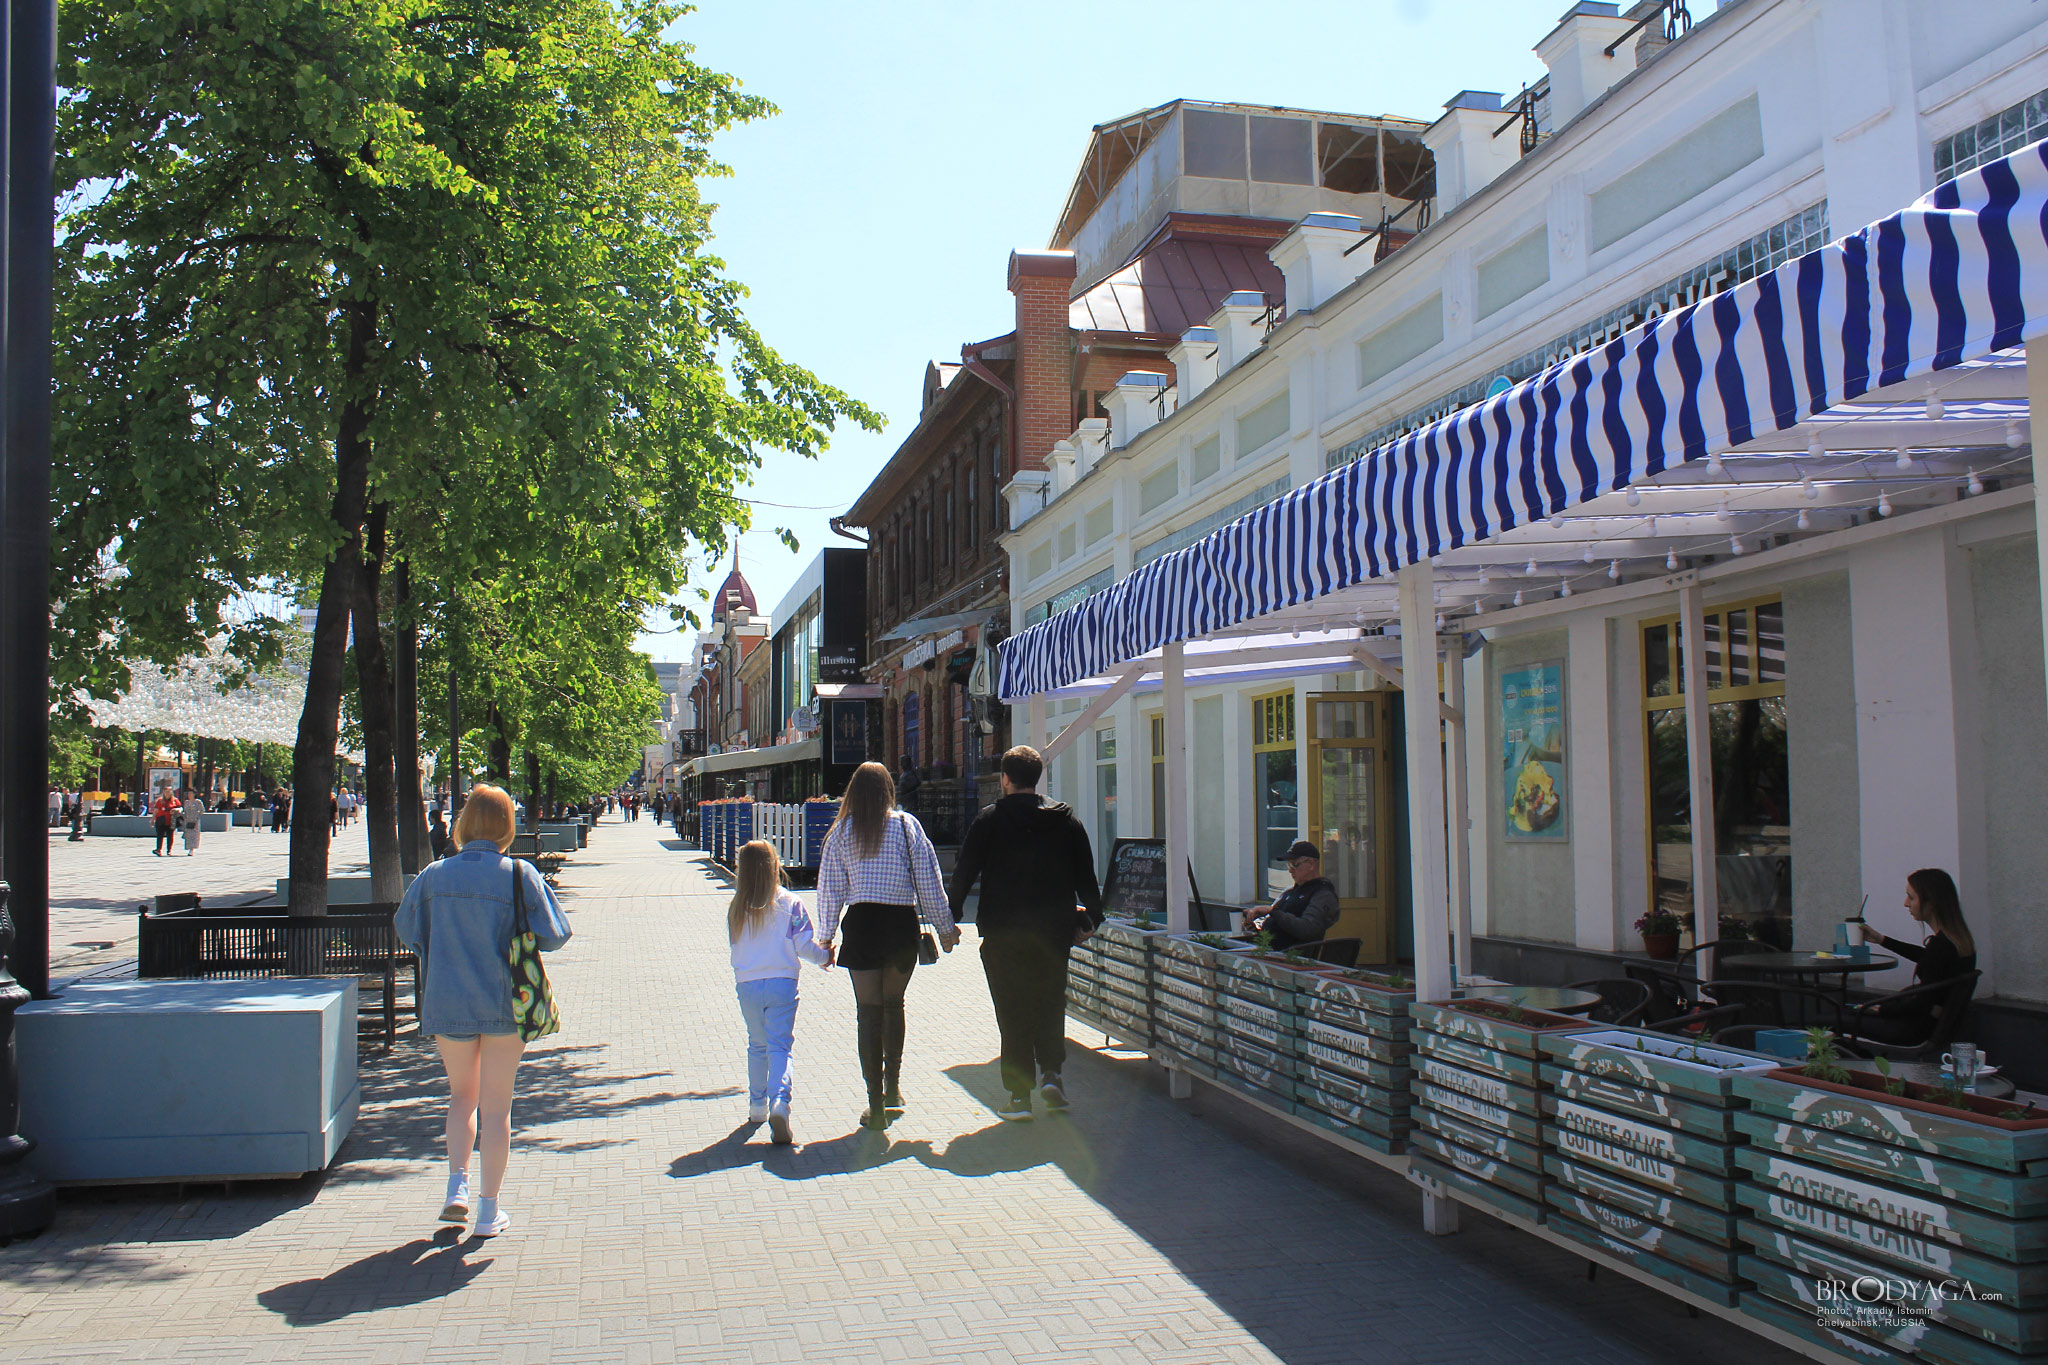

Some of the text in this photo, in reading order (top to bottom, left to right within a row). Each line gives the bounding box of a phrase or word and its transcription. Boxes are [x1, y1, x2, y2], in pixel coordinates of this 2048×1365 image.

[820, 655, 856, 665] illusion
[1229, 1001, 1275, 1040] COFFEE CAKE
[1311, 1027, 1366, 1071] COFFEE CAKE
[1431, 1065, 1502, 1119] COFFEE CAKE
[1565, 1110, 1668, 1179] COFFEE CAKE
[1778, 1170, 1941, 1265] COFFEE CAKE
